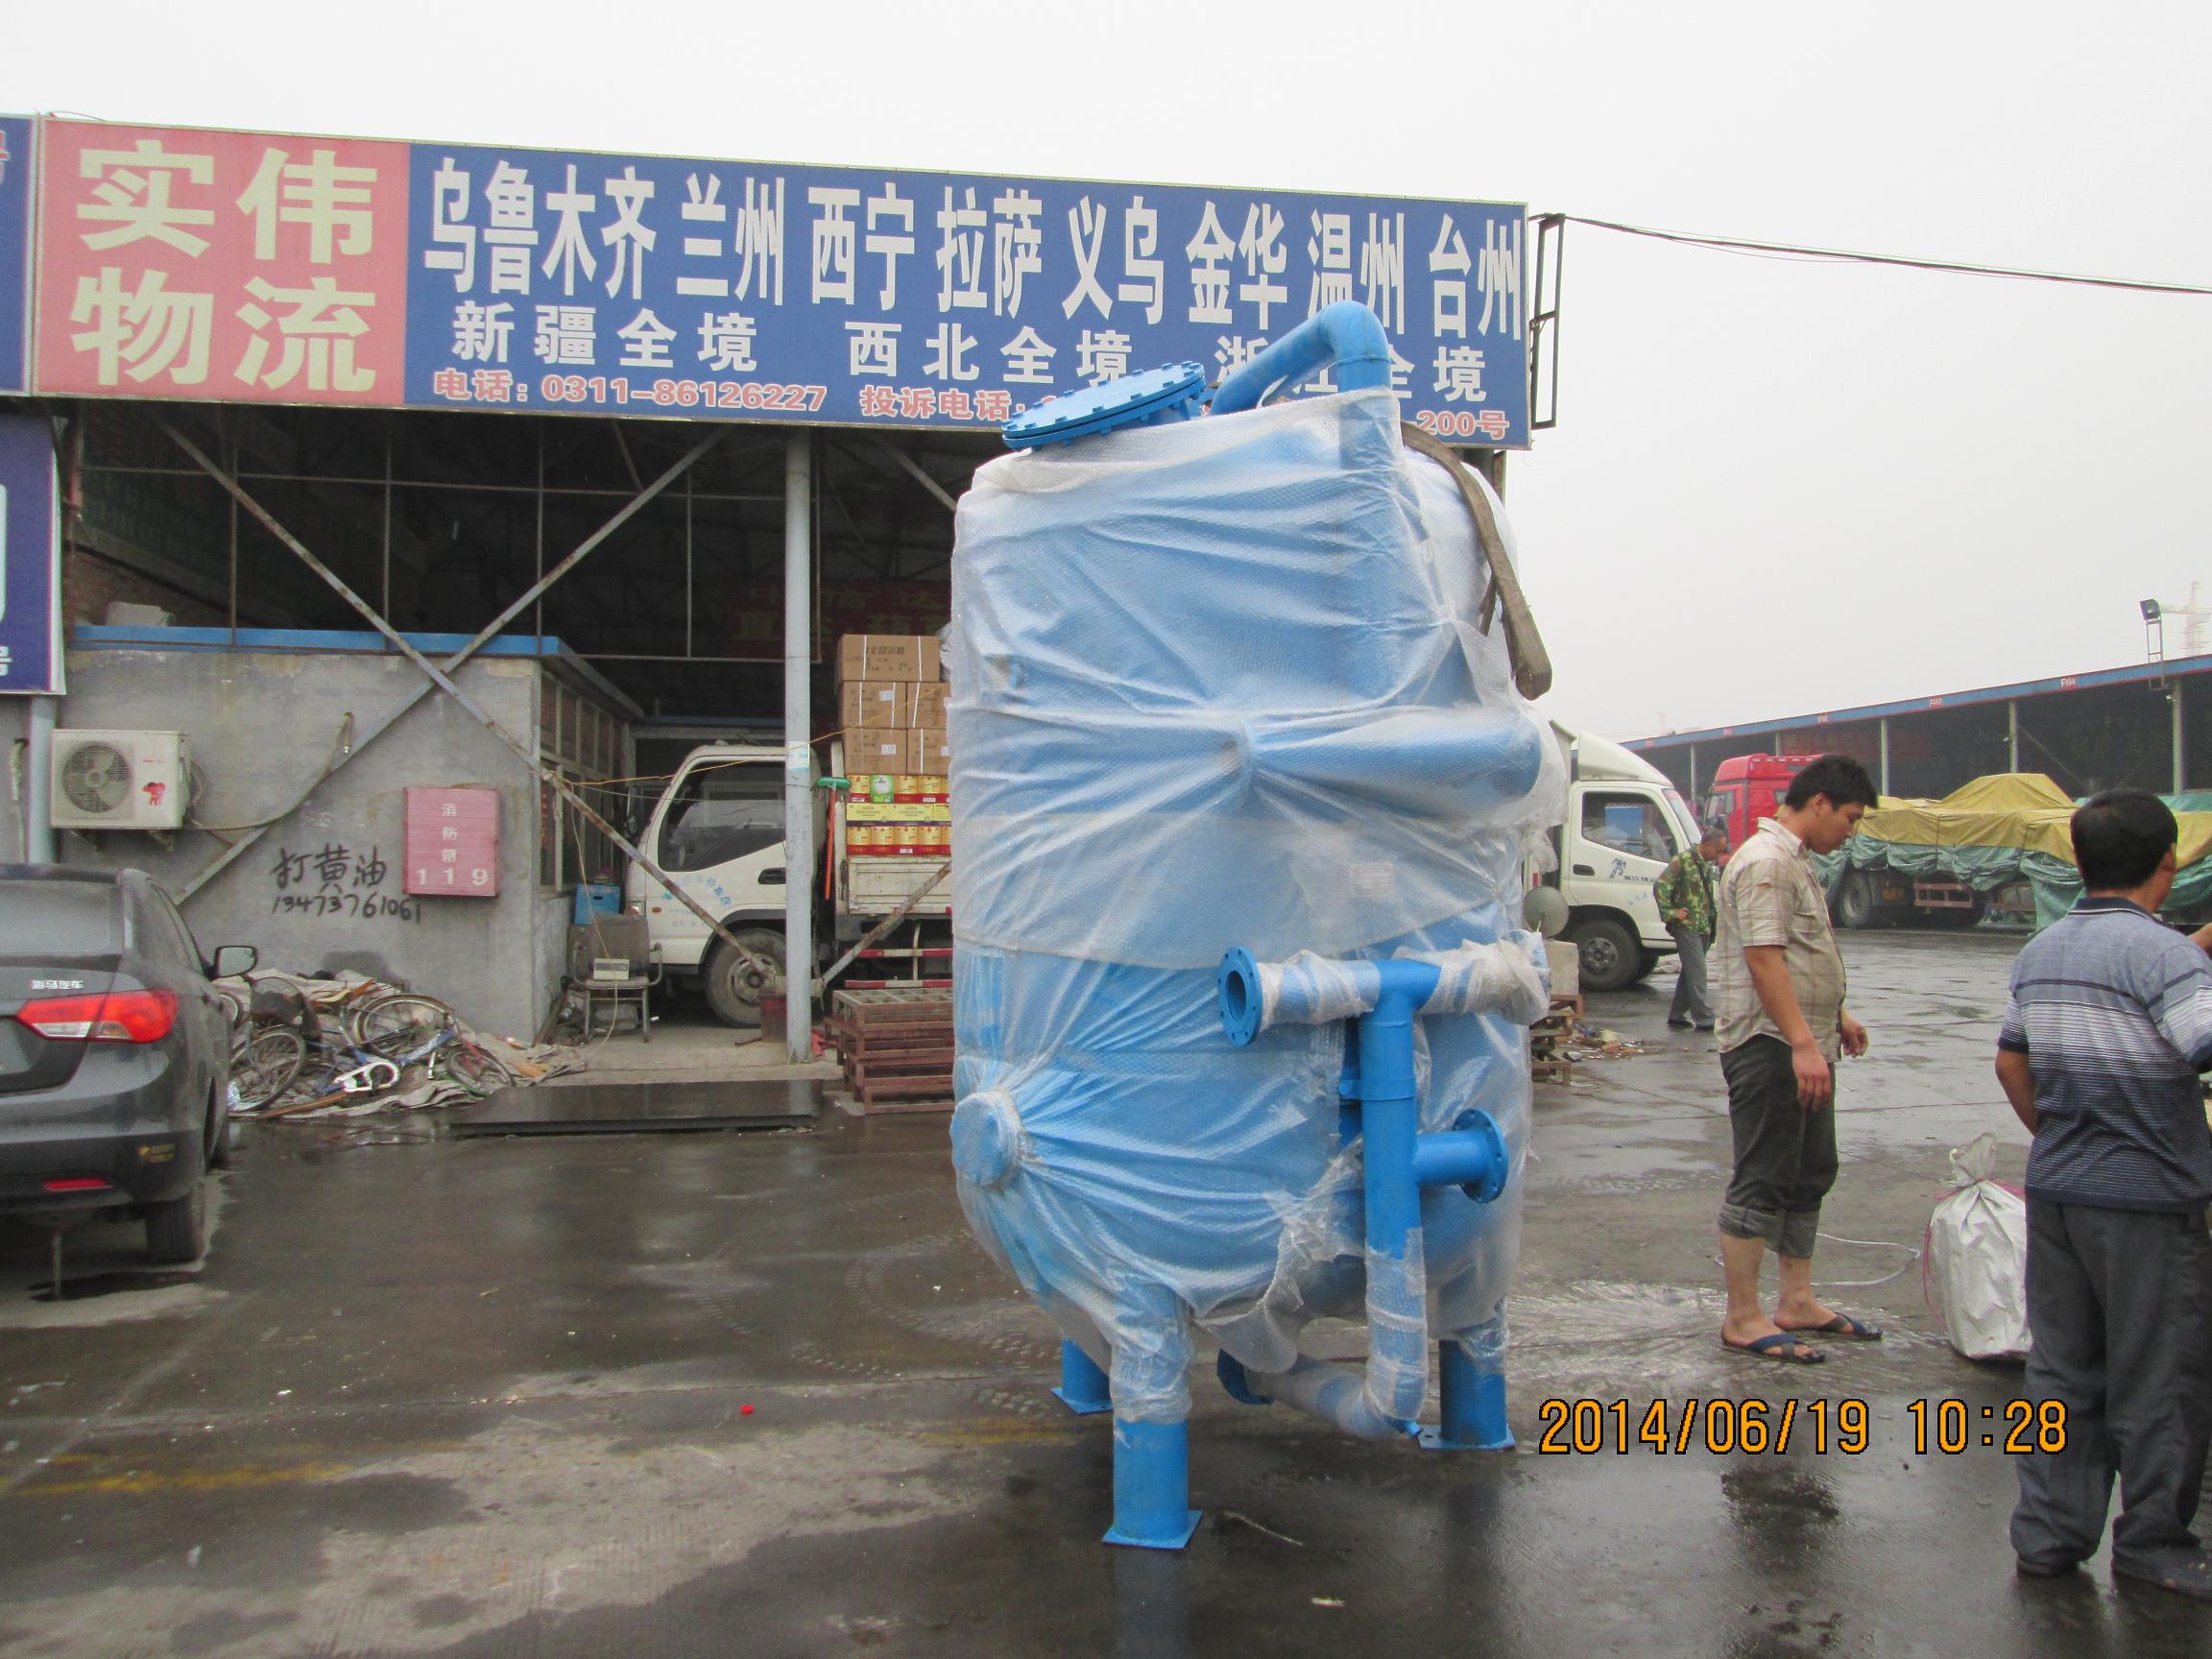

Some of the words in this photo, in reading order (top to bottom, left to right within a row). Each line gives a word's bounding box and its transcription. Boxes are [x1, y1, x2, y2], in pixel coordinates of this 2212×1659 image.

[77, 139, 377, 264] 实伟
[424, 156, 657, 301] 乌鲁木齐
[677, 173, 785, 306] 兰州
[808, 182, 916, 311] 西宁
[936, 186, 1044, 319] 拉萨
[1062, 195, 1165, 325] 义乌
[1186, 201, 1288, 330] 金华
[1308, 208, 1405, 335] 温州
[1429, 213, 1522, 341] 台州
[70, 267, 376, 391] 物流
[451, 300, 757, 373] 新疆全境
[846, 321, 1133, 388] 西北全境
[270, 843, 387, 893] 打黄油
[416, 868, 489, 886] 119
